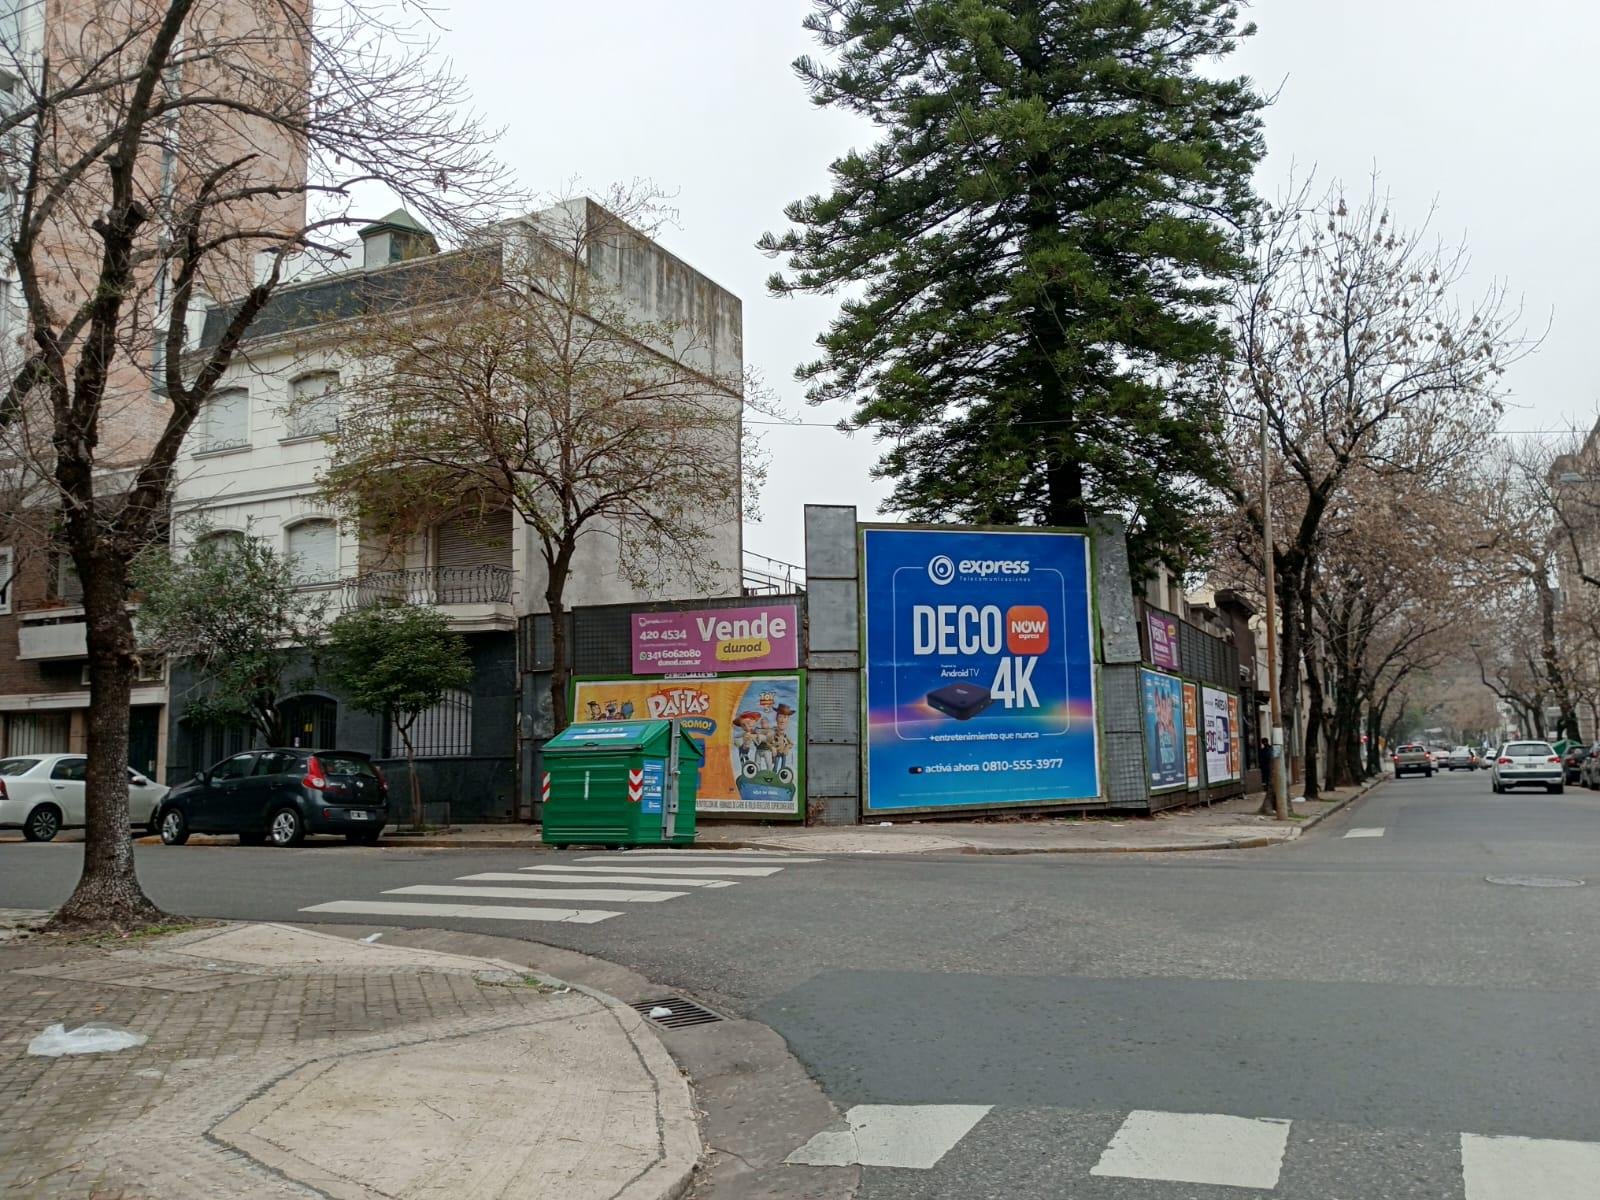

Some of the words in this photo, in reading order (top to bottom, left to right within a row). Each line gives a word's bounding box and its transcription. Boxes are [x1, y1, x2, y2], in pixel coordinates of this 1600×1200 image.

[959, 559, 1030, 577] express
[695, 612, 787, 642] Vende
[913, 605, 1002, 655] DECO
[1011, 620, 1046, 634] NOW
[640, 630, 660, 641] 420
[660, 629, 688, 641] 4534
[723, 641, 762, 654] dunod
[940, 669, 969, 678] Android
[969, 668, 980, 677] TV
[990, 656, 1040, 709] 4K
[680, 720, 713, 731] ROMO!
[999, 731, 1014, 742] que
[1015, 730, 1040, 740] nunca
[953, 761, 980, 773] ahora
[982, 758, 1064, 772] 0810-555-3977
